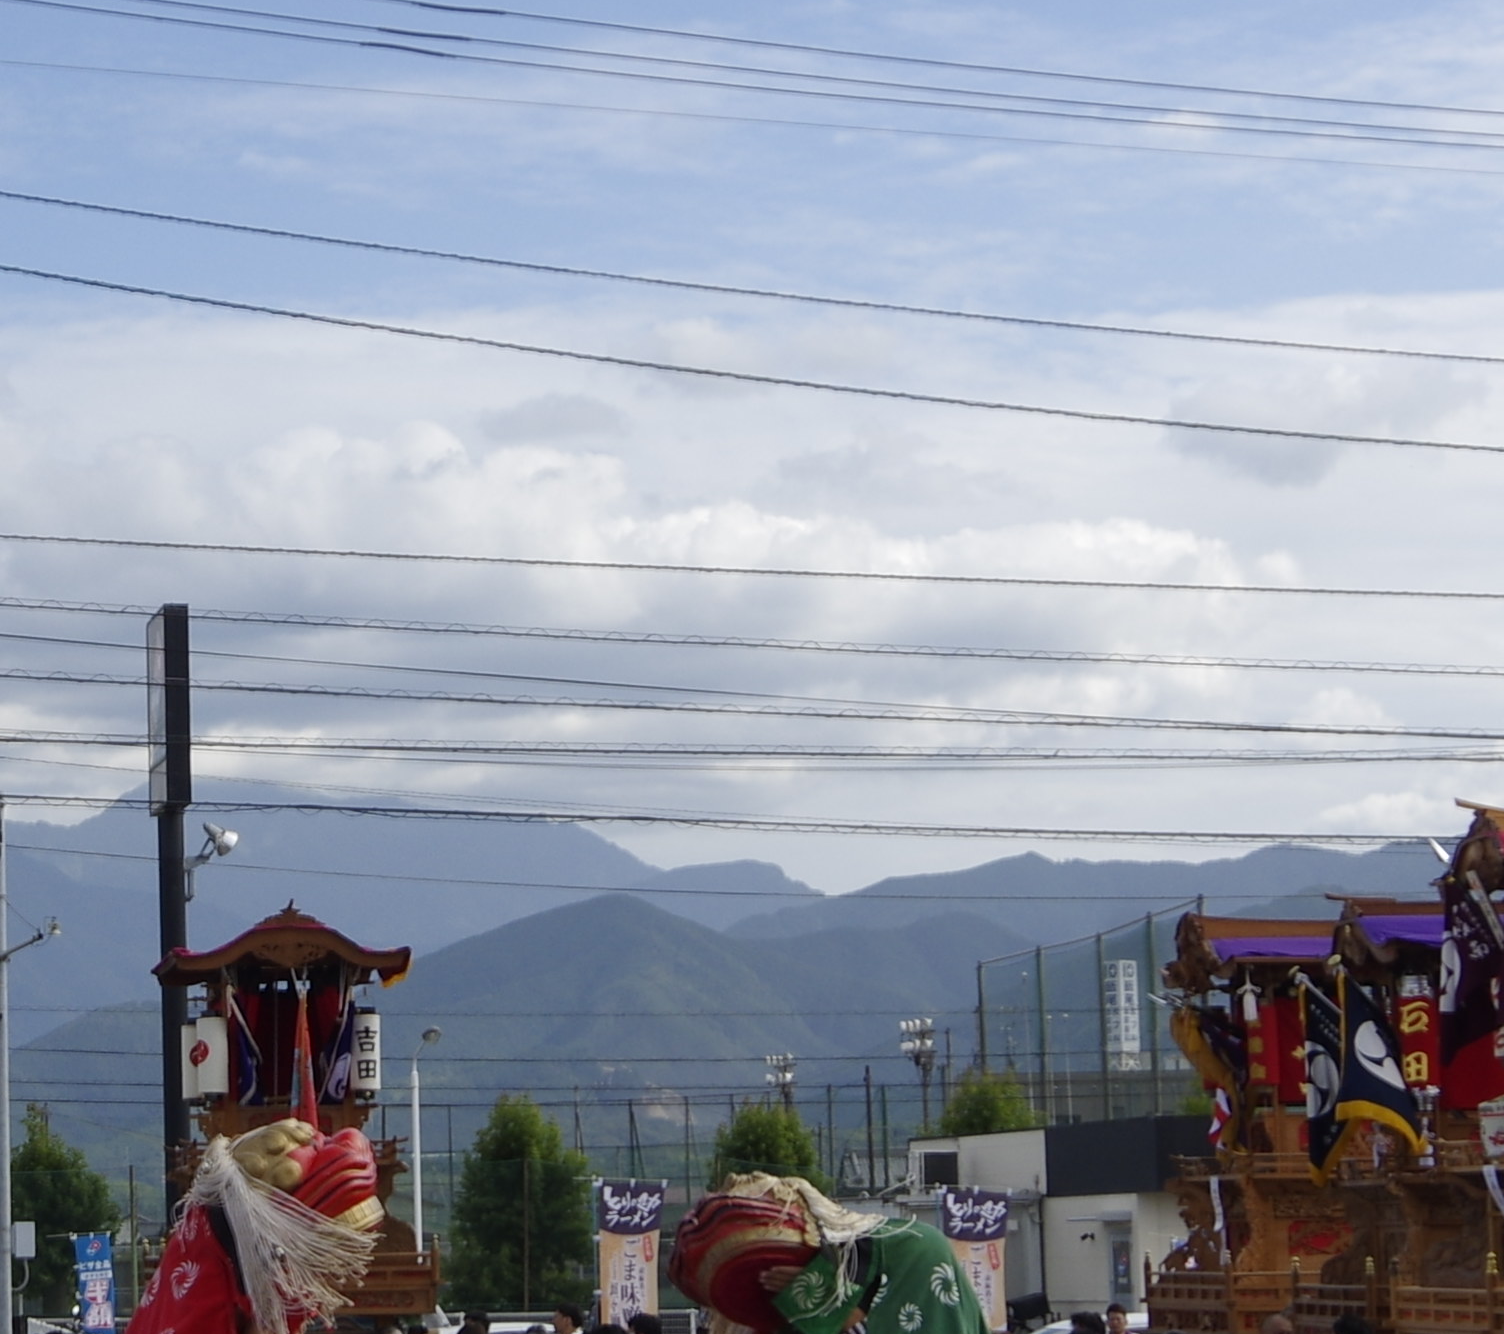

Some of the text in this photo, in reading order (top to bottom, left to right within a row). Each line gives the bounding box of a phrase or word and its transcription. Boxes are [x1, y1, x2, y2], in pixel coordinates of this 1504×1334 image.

[356, 1026, 378, 1079] 吉田
[603, 1185, 662, 1213] とりの助
[606, 1211, 656, 1228] ラーメン
[949, 1217, 1001, 1234] ラーメン
[84, 1278, 114, 1329] 半額
